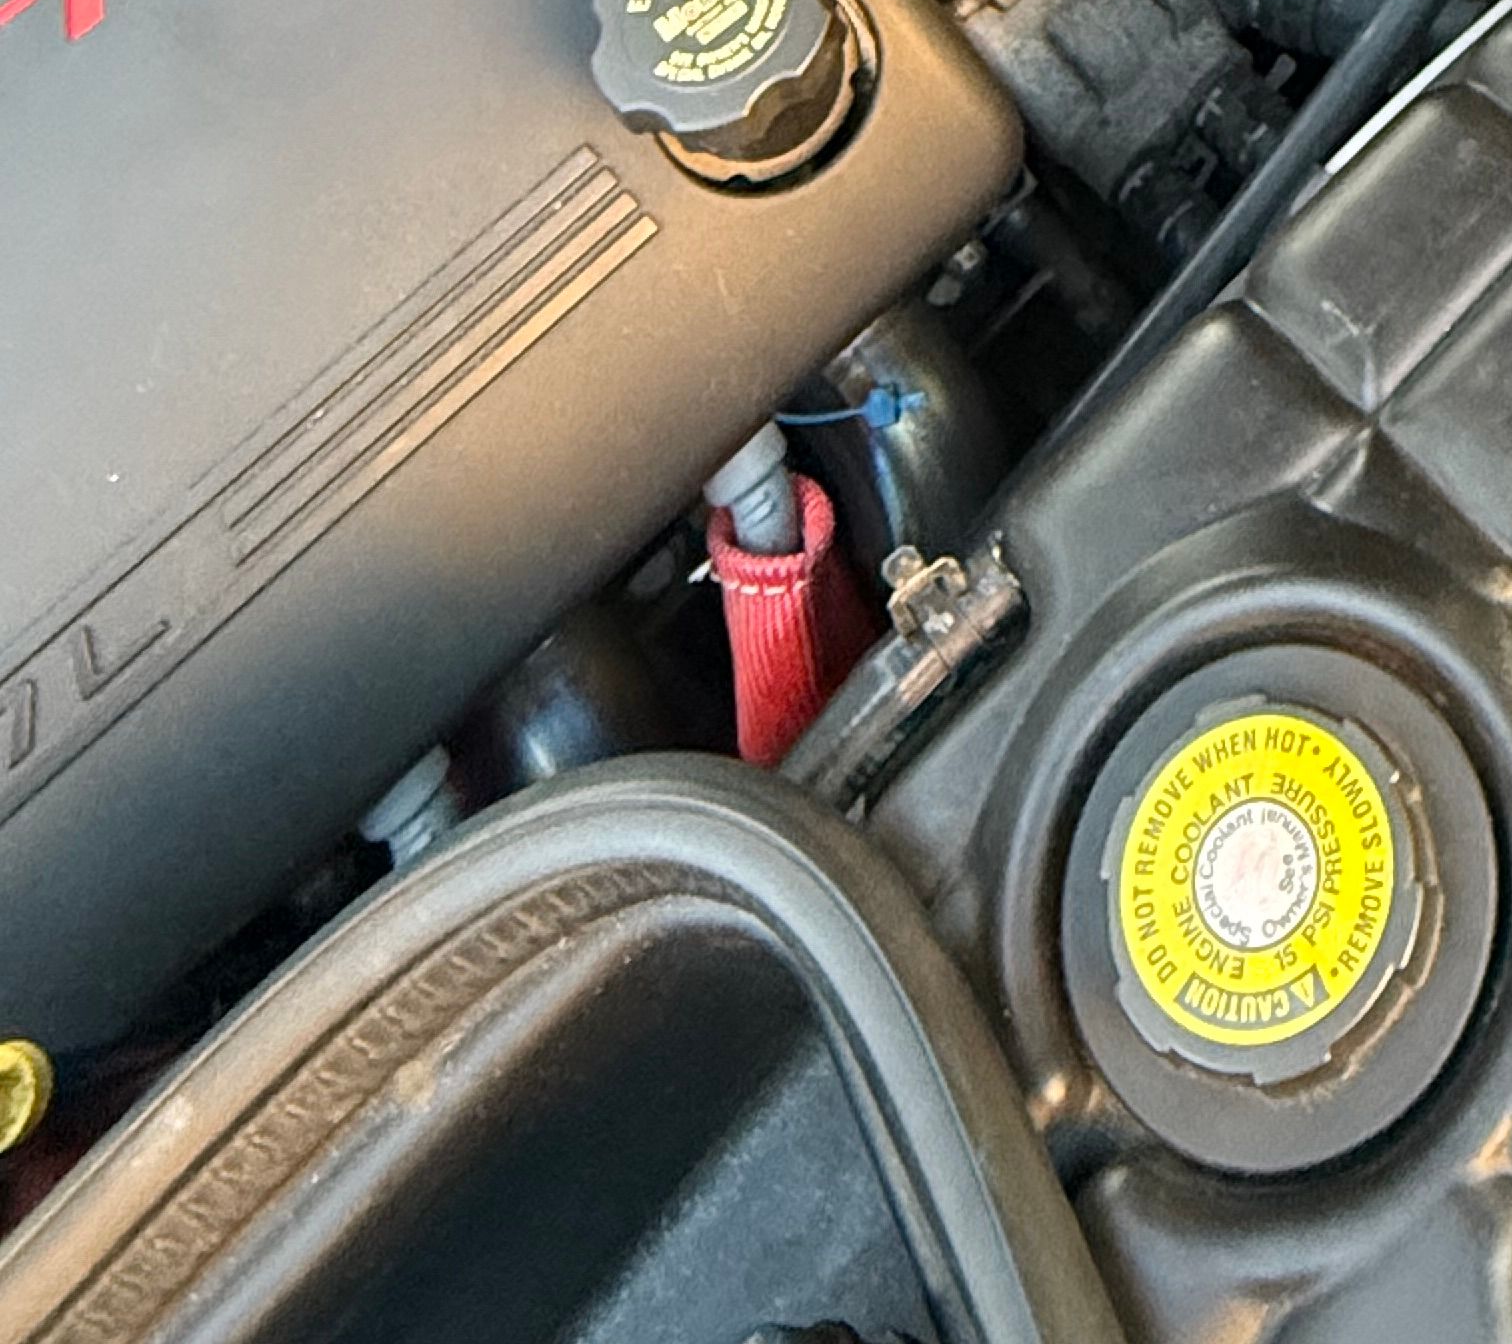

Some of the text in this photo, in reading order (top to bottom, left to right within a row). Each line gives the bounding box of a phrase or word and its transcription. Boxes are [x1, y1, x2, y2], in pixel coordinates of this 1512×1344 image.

[1132, 726, 1311, 984] DO NOT REMOVE WHEN HOT
[1170, 772, 1254, 980] ENGINE COOLANT
[1199, 807, 1254, 947] Special Coolant
[1260, 807, 1314, 938] Owner's Manual
[1270, 772, 1343, 972] 15 PSI PRESSURE
[1277, 853, 1295, 894] See
[1322, 755, 1384, 973] REMOVE SLOWLY
[1184, 980, 1291, 1023] CAUTION
